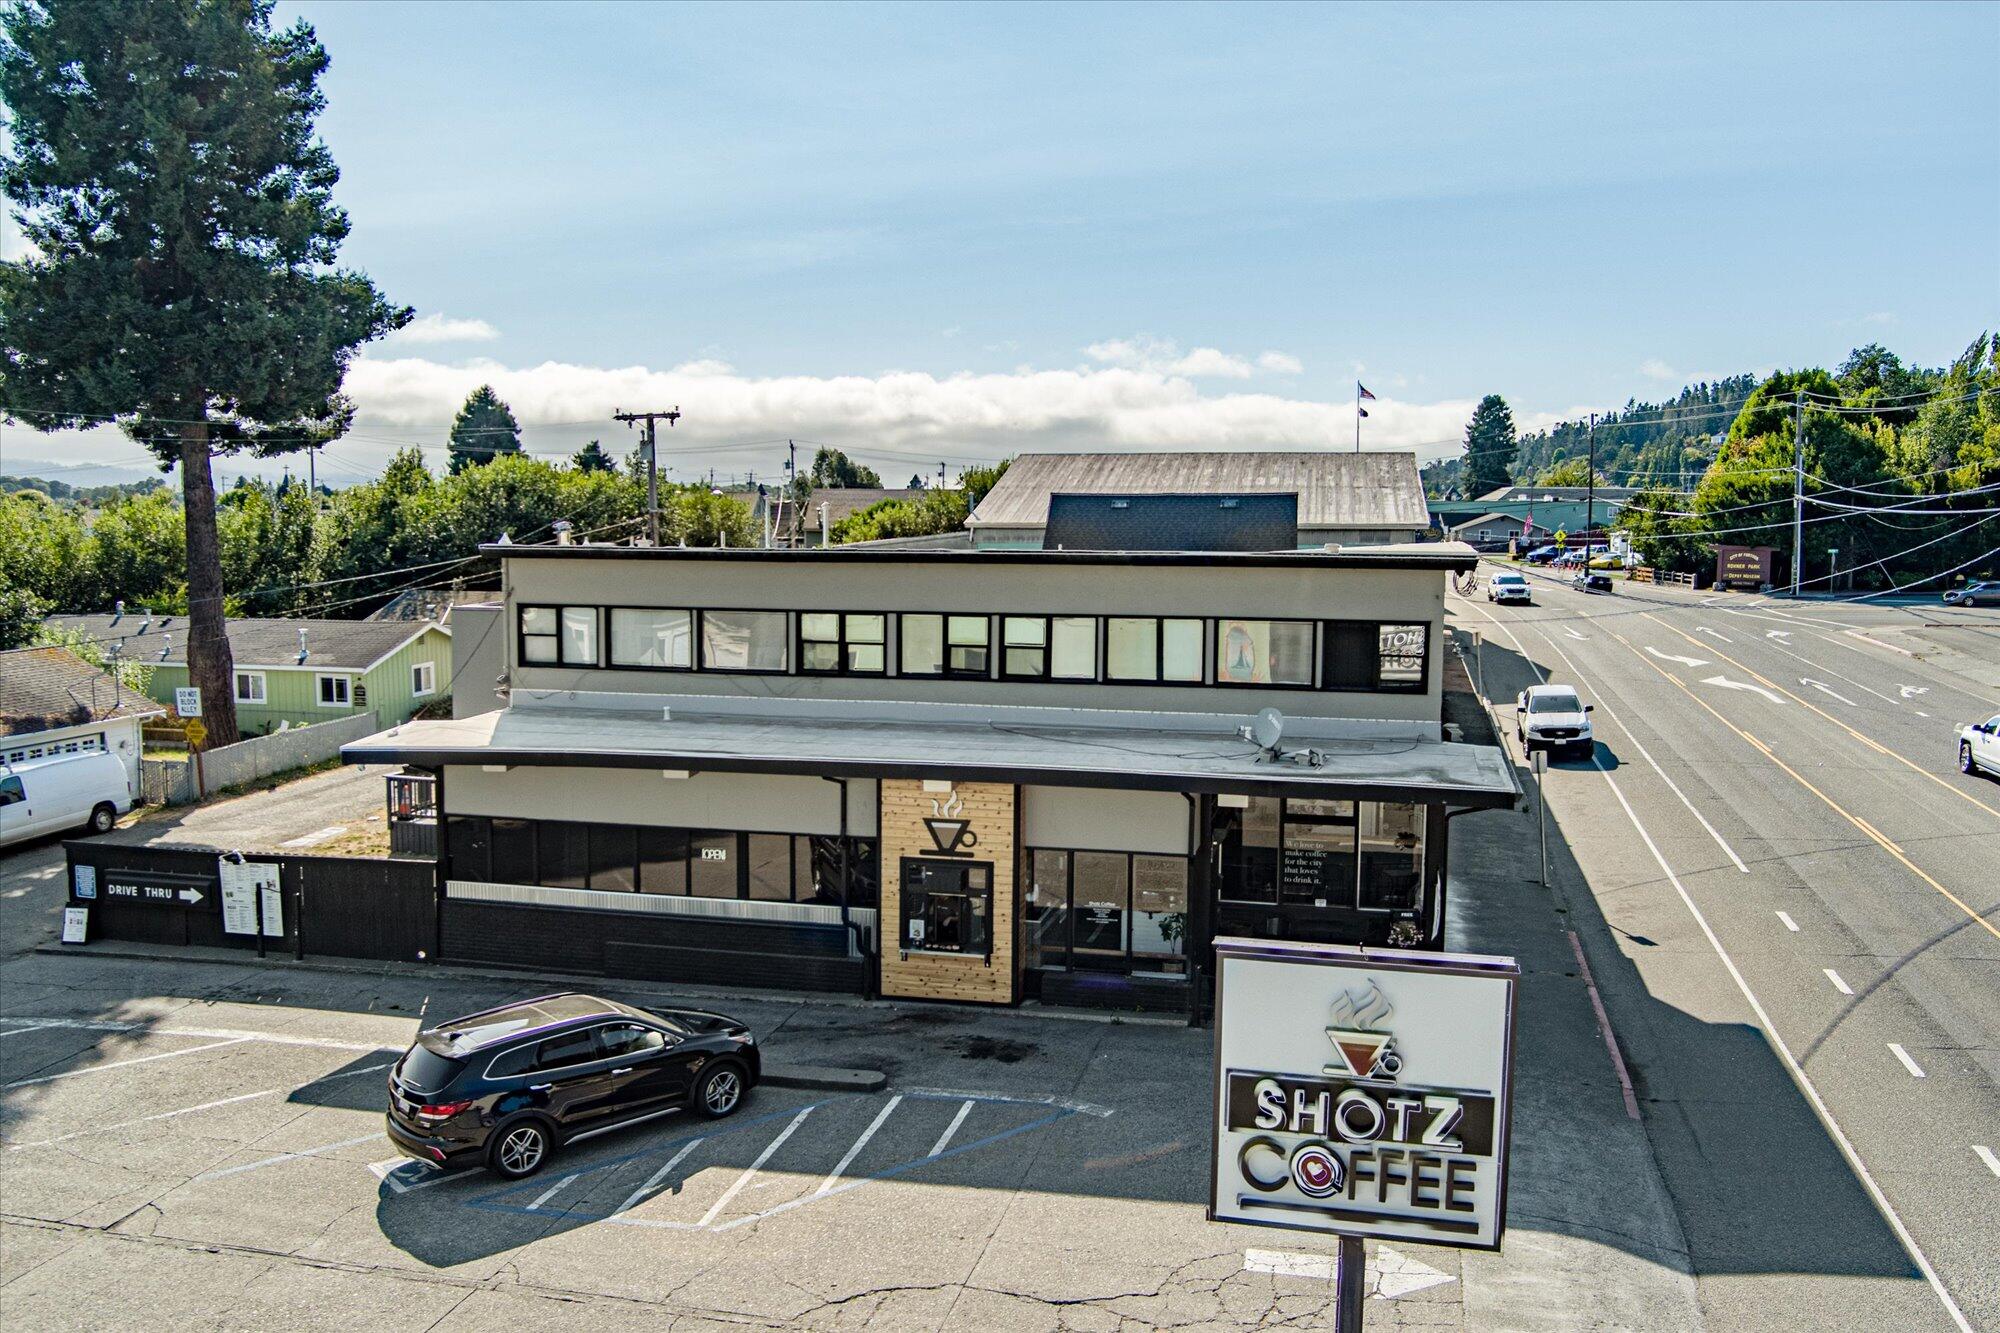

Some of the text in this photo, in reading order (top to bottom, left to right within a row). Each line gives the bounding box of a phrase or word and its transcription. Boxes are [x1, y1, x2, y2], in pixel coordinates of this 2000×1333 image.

[179, 690, 197, 698] DO NOT
[180, 698, 197, 706] BLOCK
[181, 705, 197, 713] ALLEY
[1285, 840, 1299, 848] We
[1299, 840, 1314, 849] love
[703, 848, 726, 860] OPEN
[1285, 849, 1328, 858] make coffee
[1284, 857, 1322, 869] for the city
[1284, 866, 1319, 875] that loves
[1292, 876, 1313, 884] drink
[108, 884, 173, 899] DRIVE THRU
[1254, 1079, 1464, 1153] SHOTZ
[1238, 1135, 1477, 1212] COFFEE
